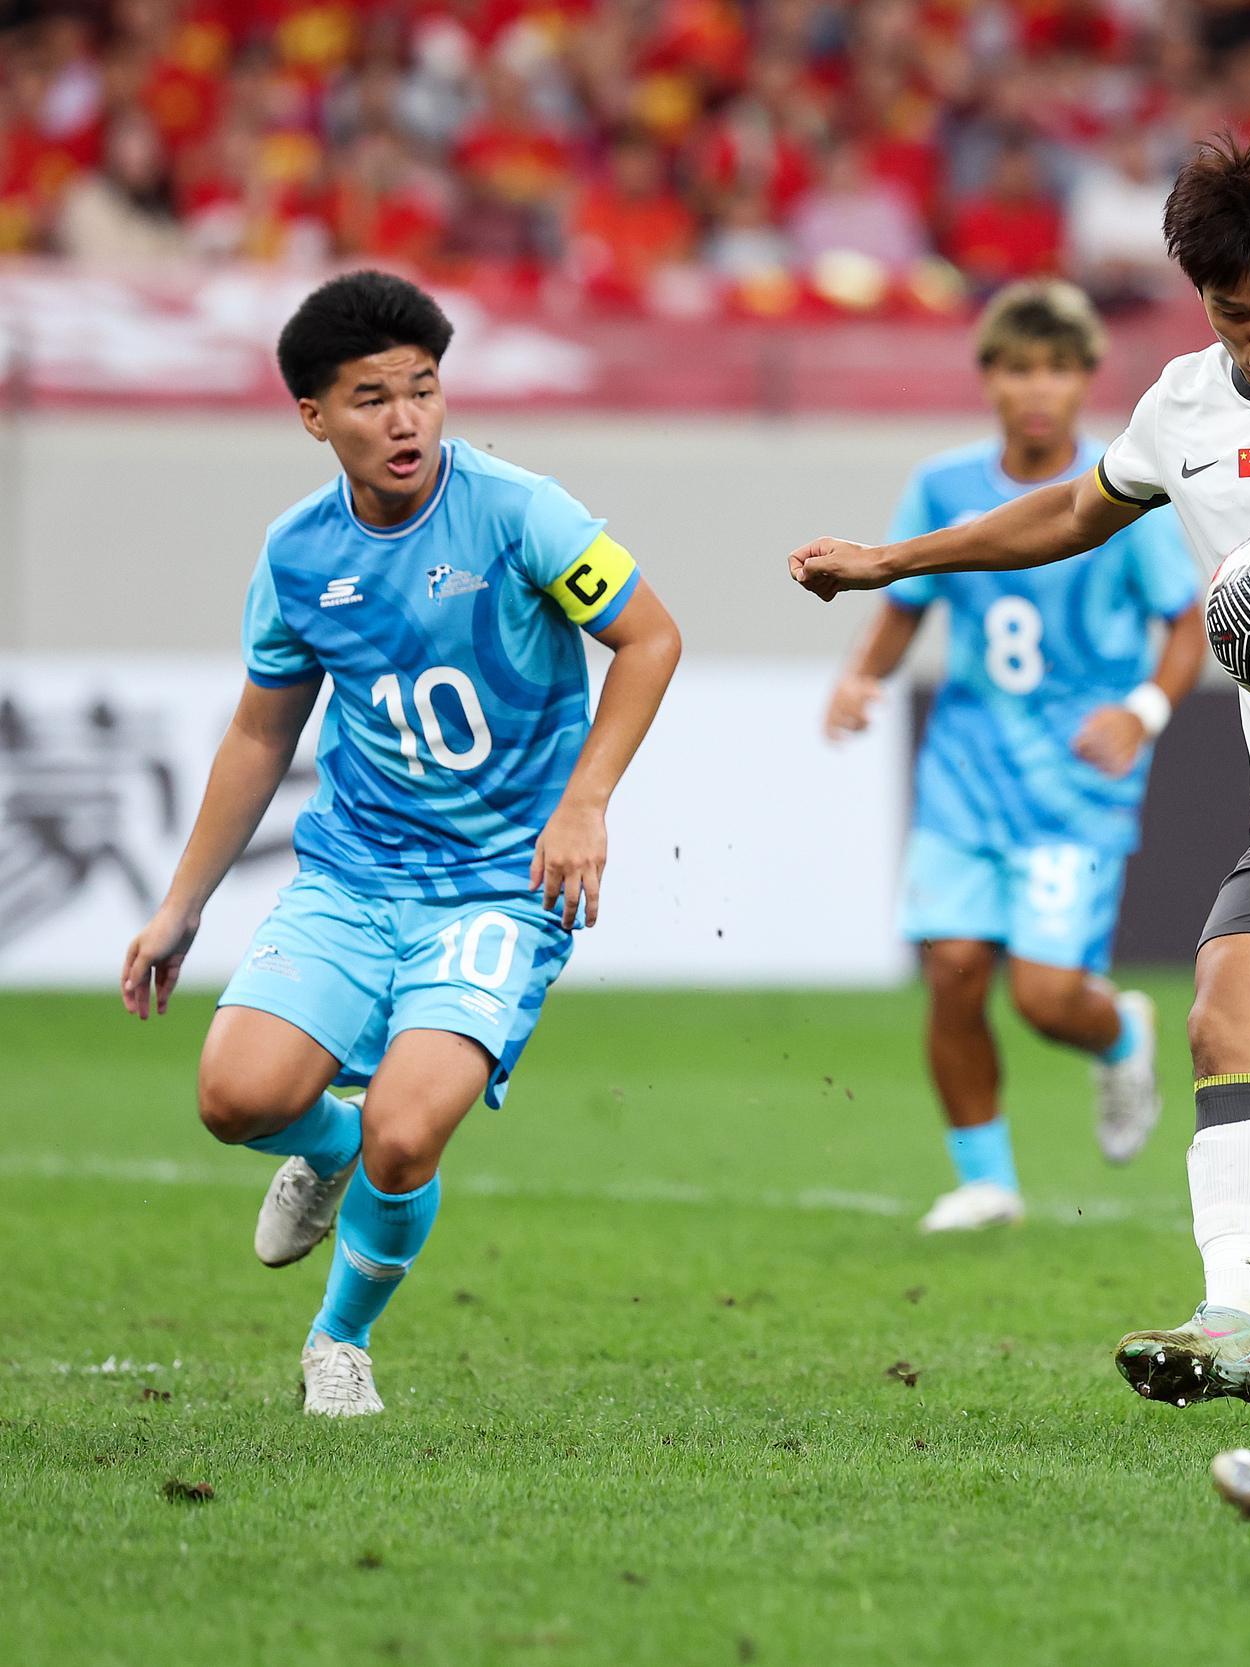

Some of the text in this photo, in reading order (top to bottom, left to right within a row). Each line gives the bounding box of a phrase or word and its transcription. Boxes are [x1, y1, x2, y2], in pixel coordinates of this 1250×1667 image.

[566, 563, 608, 606] C
[984, 595, 1045, 695] 8
[371, 665, 492, 776] 10
[1028, 844, 1081, 910] 8
[433, 911, 519, 990] 10
